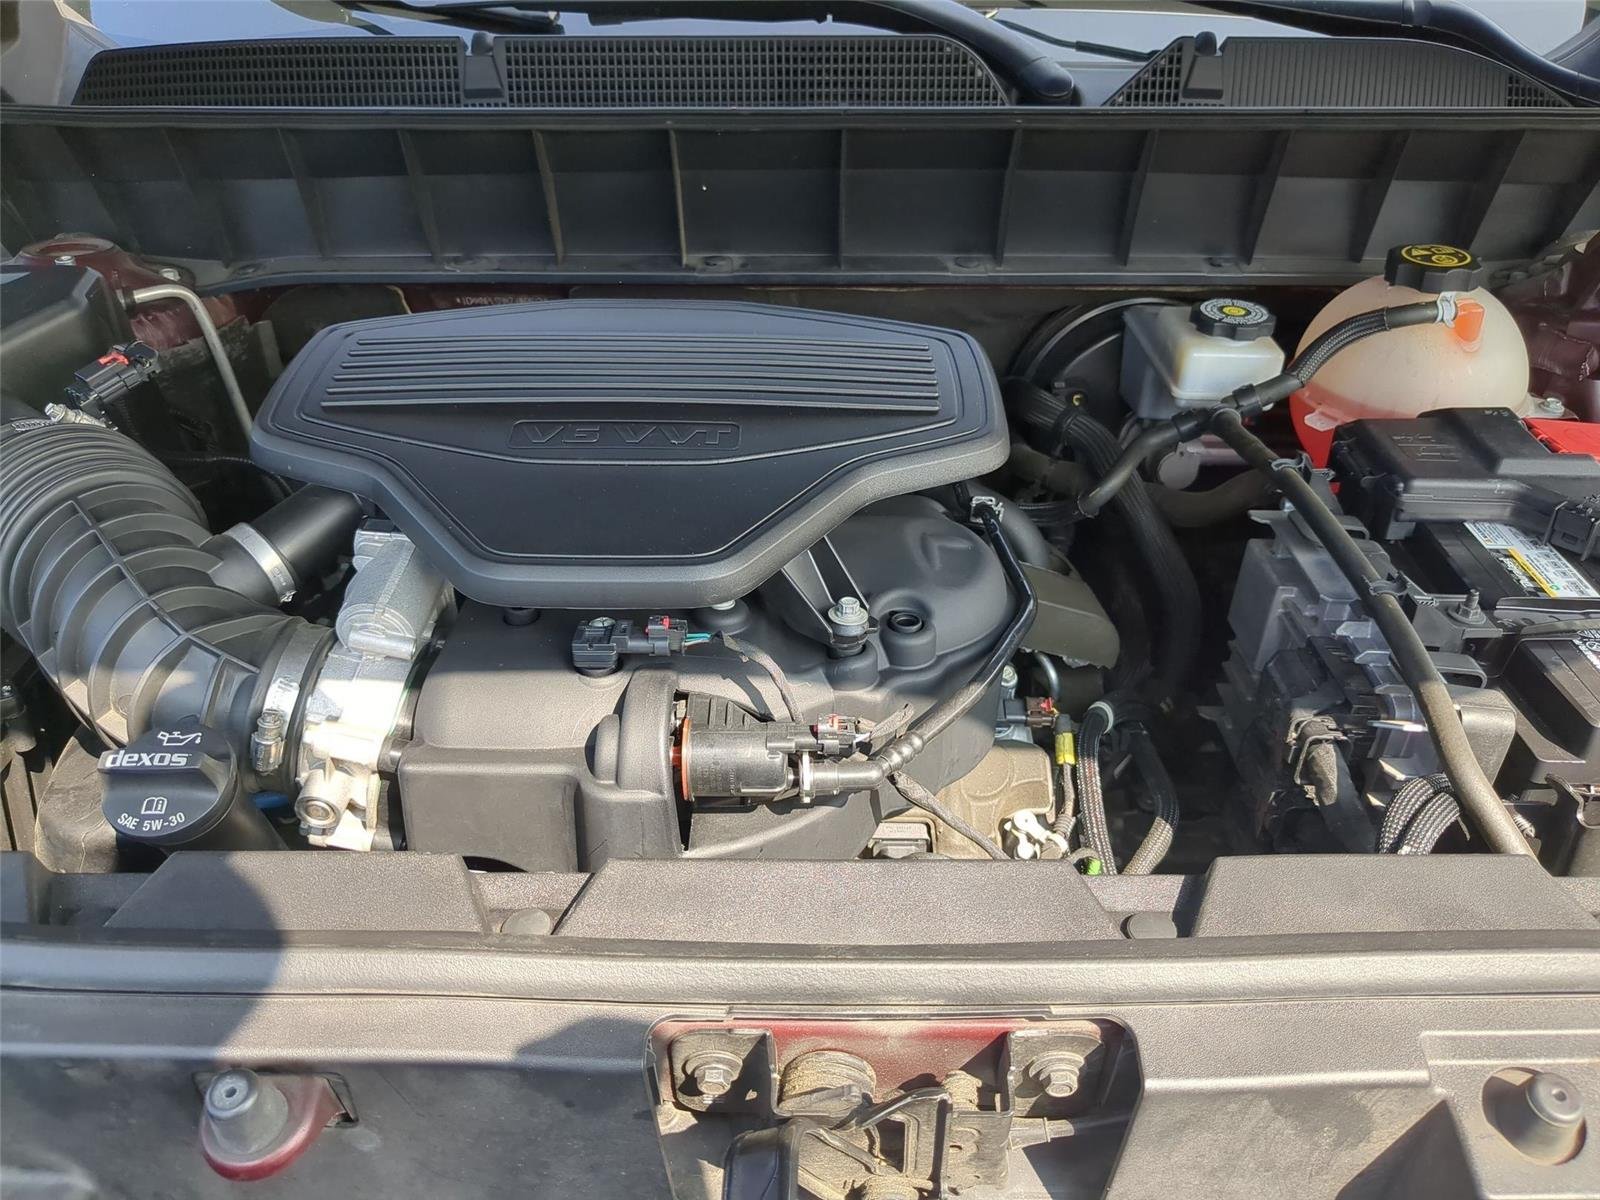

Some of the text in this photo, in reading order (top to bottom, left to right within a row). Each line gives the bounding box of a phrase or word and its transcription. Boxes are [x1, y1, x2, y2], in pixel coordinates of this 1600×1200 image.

[523, 424, 732, 445] V6 VVT
[106, 749, 189, 768] dexos
[117, 812, 185, 831] SAE 5W-30
